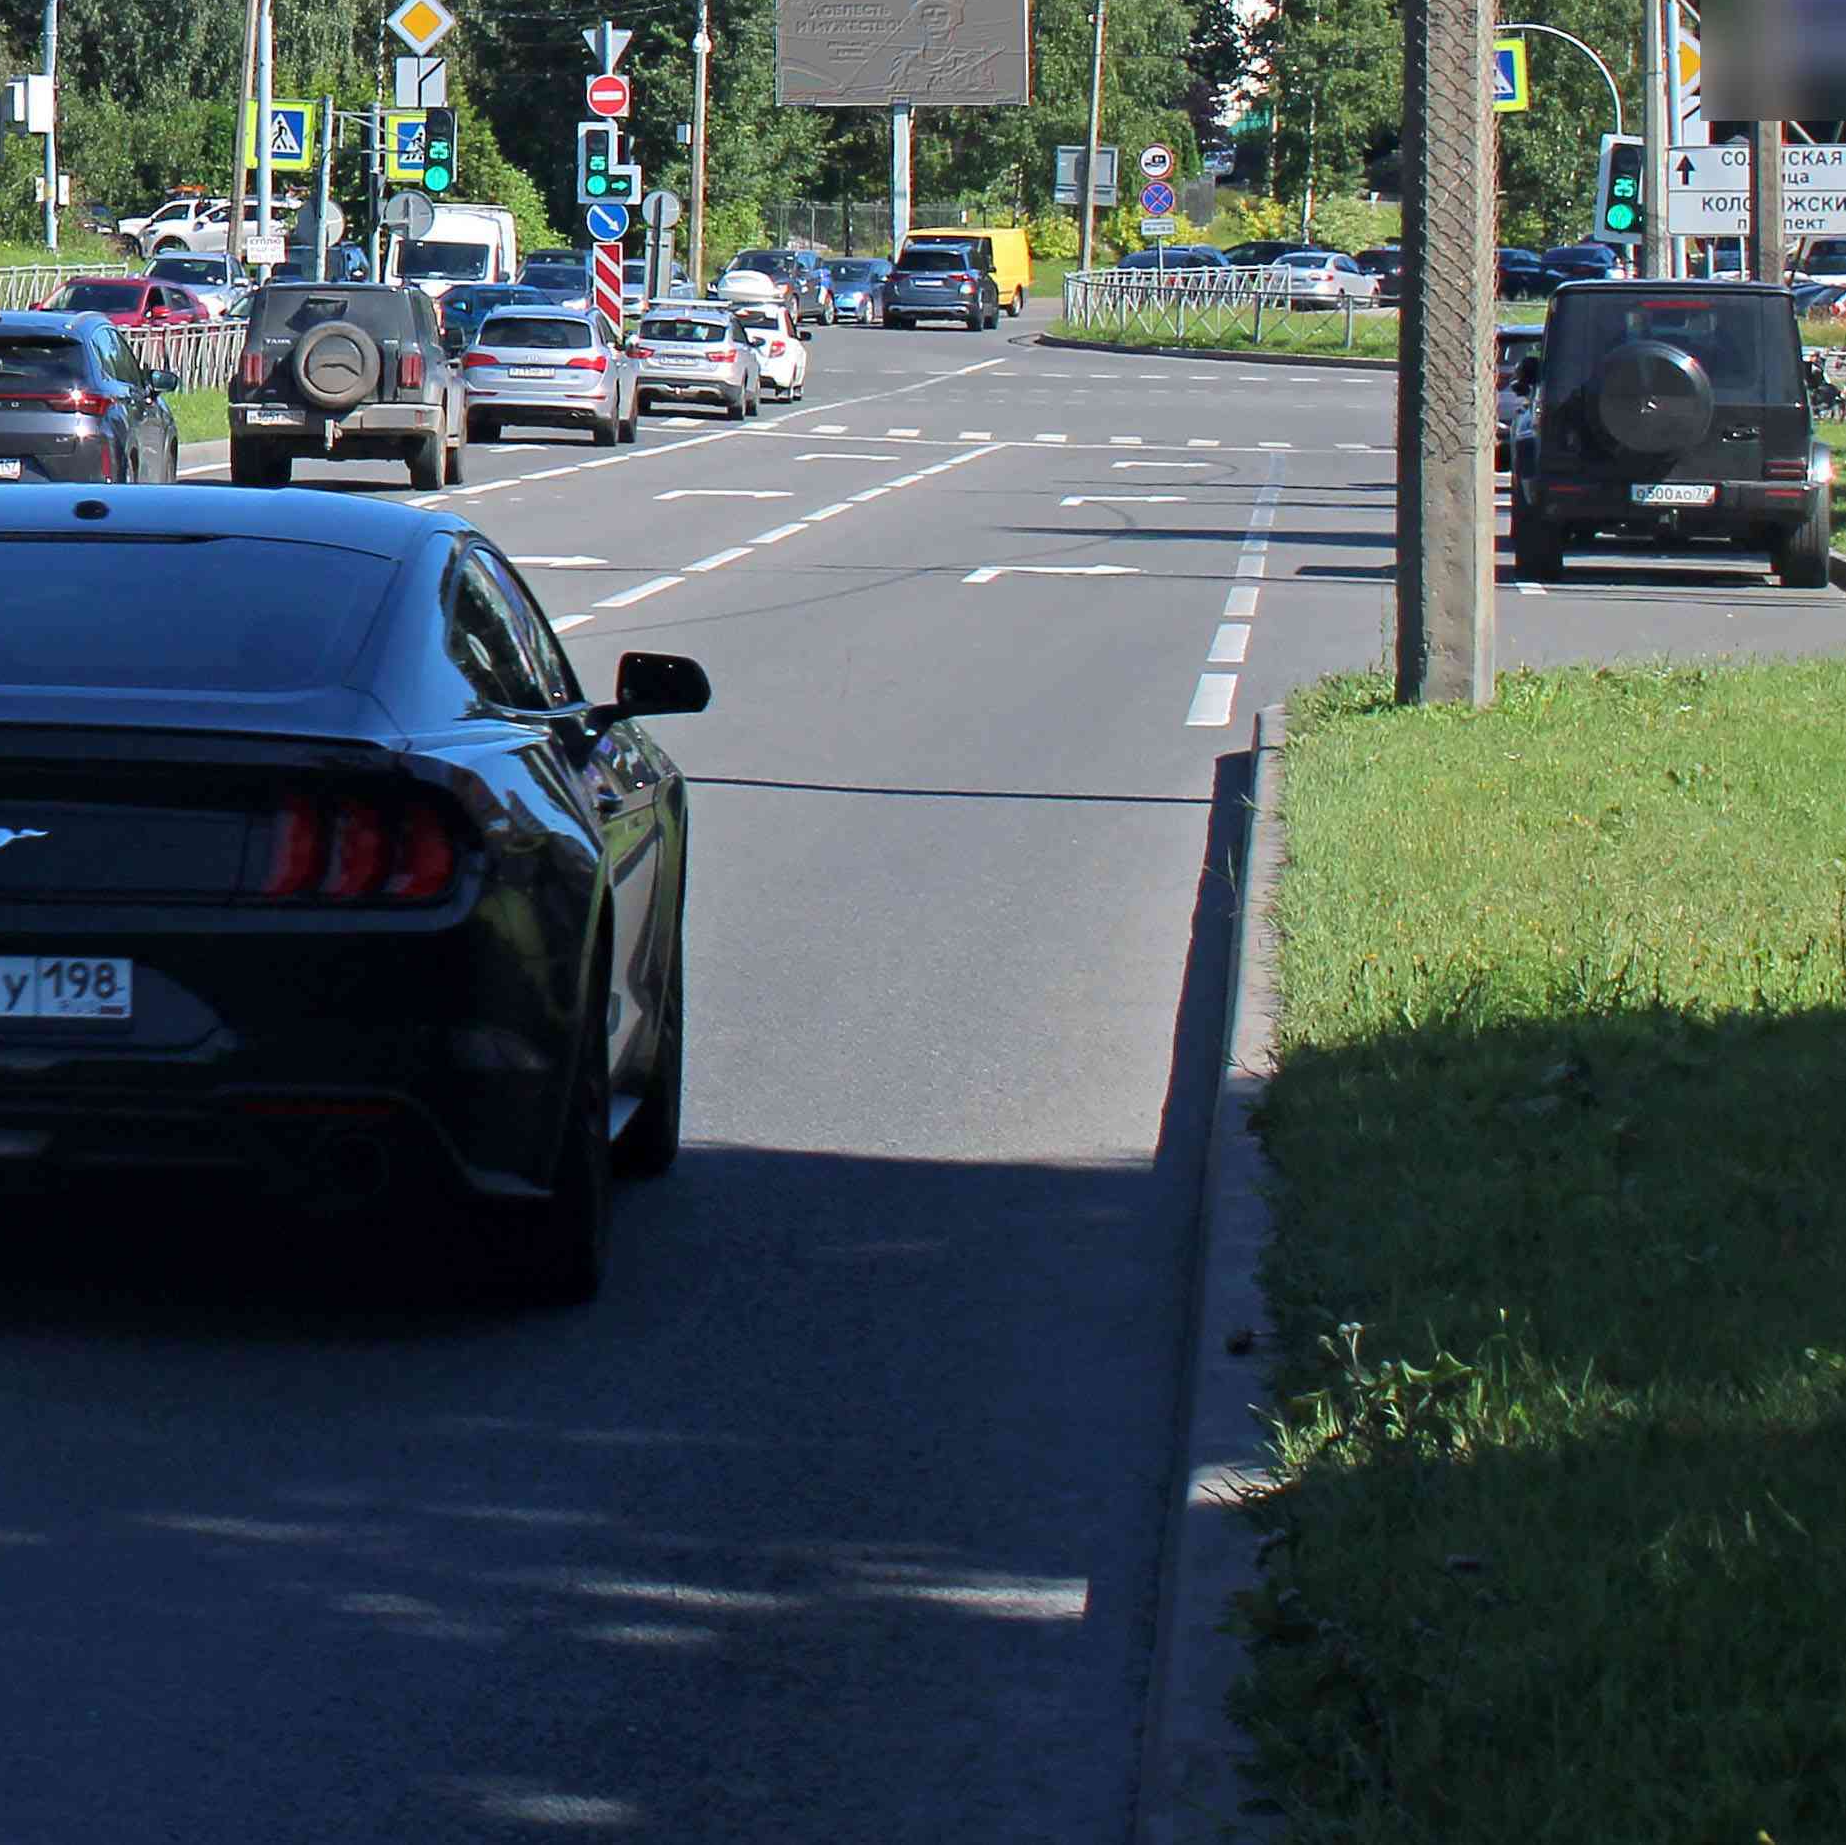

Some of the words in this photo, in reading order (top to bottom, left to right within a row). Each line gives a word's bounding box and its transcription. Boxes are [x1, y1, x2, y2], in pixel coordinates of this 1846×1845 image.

[1721, 151, 1842, 166] СОСКАЯ
[1737, 218, 1826, 230] ппект
[41, 960, 118, 1000] 198
